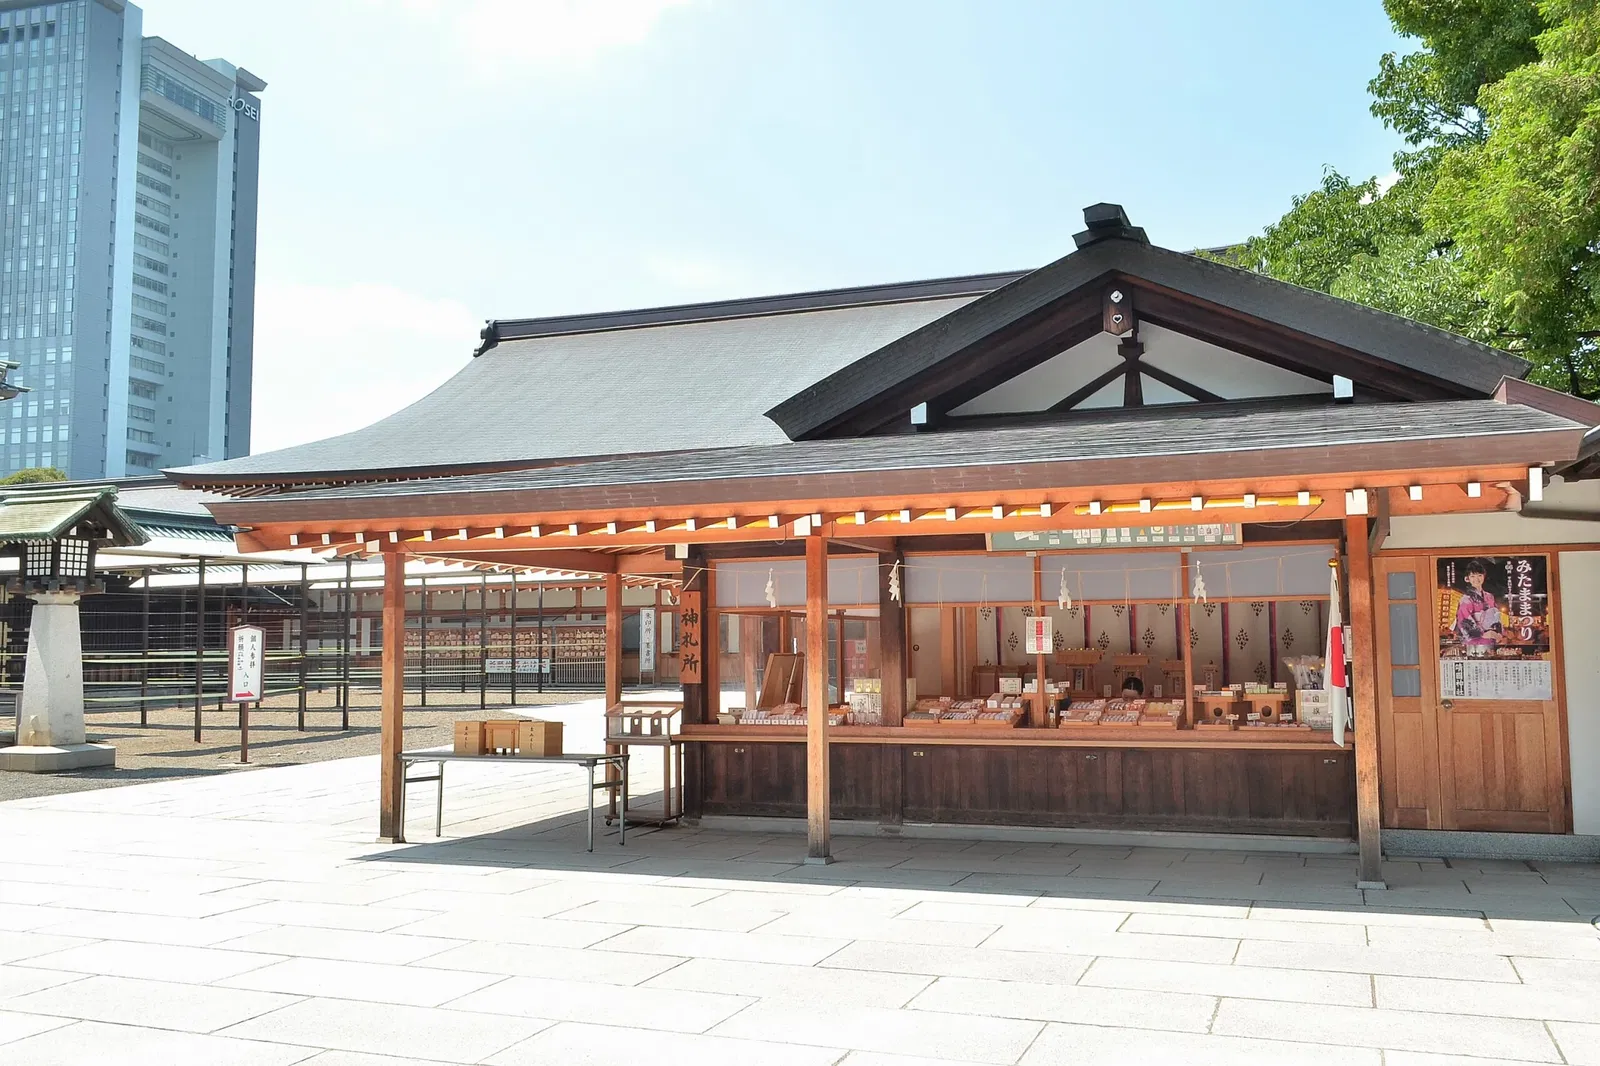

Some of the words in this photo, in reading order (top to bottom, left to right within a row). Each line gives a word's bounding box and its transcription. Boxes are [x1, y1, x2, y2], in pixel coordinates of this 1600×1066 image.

[1516, 559, 1535, 641] みたままつり
[681, 608, 699, 674] 神札所
[243, 672, 249, 687] 入口
